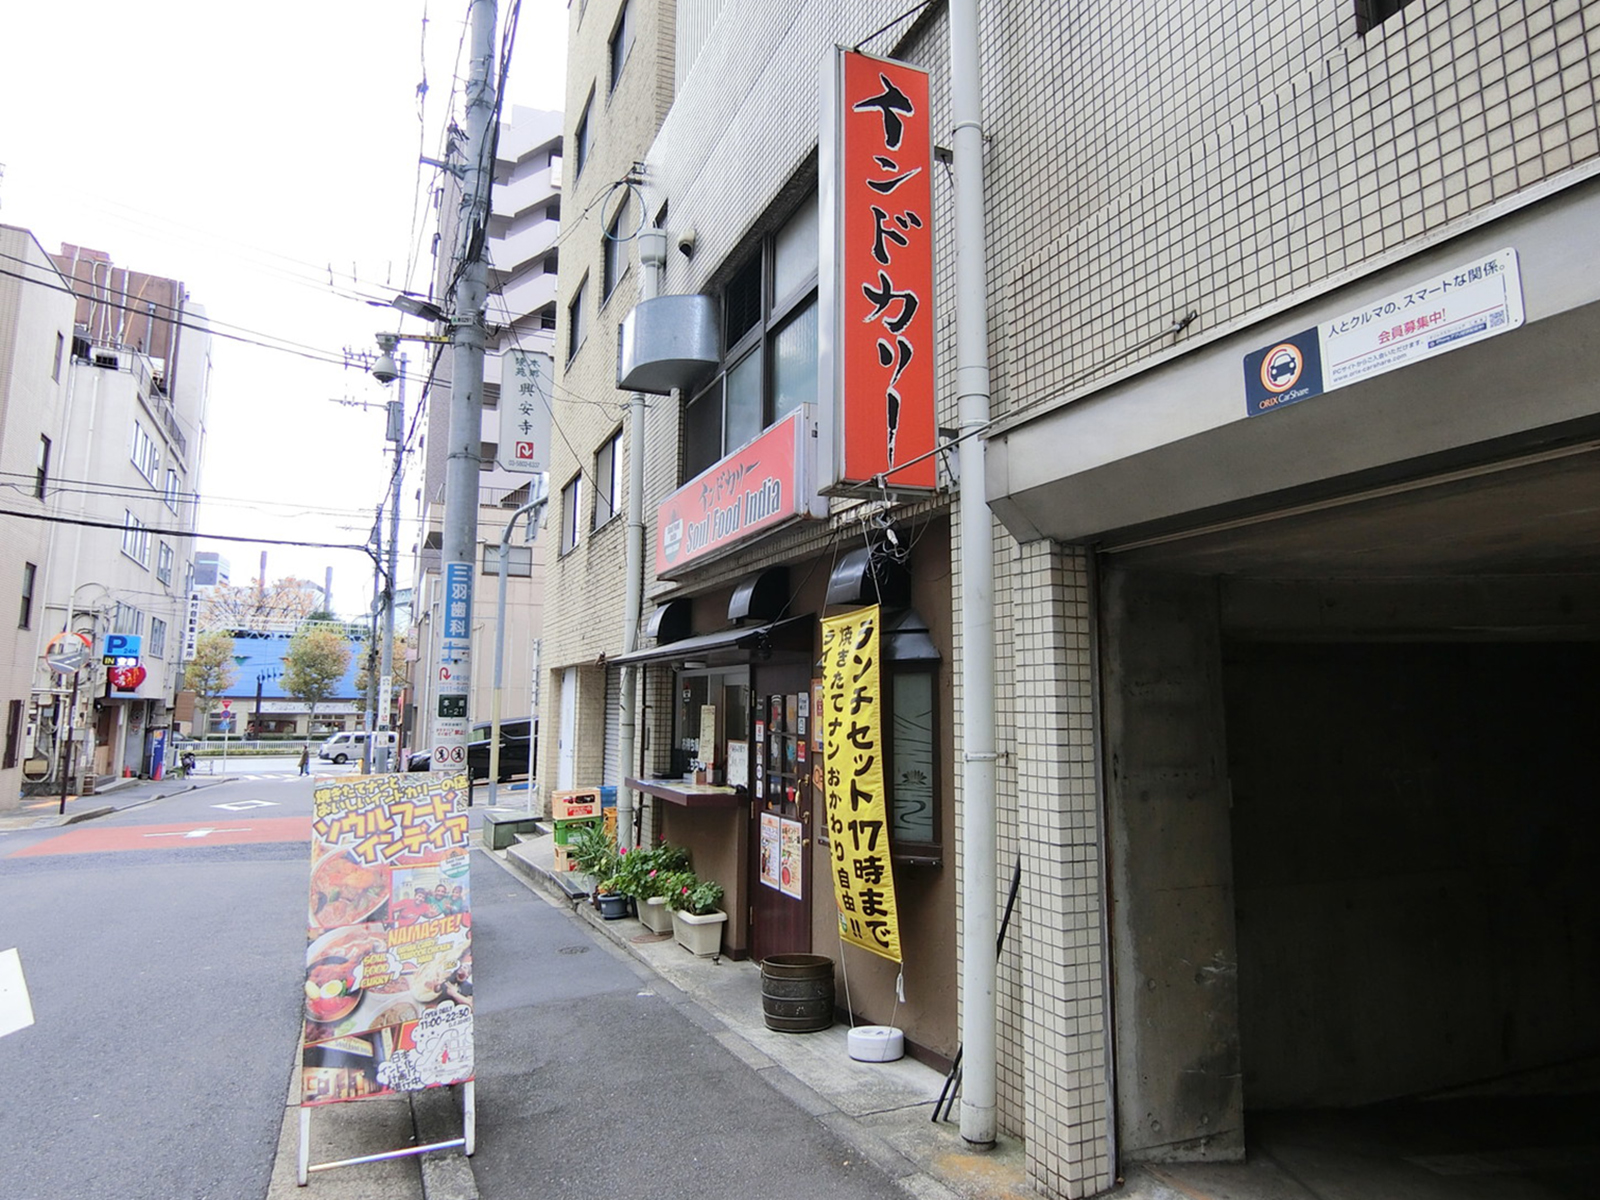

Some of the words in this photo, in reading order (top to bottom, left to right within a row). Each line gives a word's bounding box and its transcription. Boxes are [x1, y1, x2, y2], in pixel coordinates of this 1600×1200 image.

[1328, 258, 1505, 338] 人とクルマの、スマートな関係。
[1378, 308, 1446, 345] 会員募集中!
[518, 382, 535, 435] 興安寺
[1259, 396, 1279, 409] ORIX
[1279, 387, 1309, 403] CarShare
[687, 510, 710, 555] Soul
[711, 495, 742, 542] Food
[744, 477, 782, 528] India
[449, 565, 468, 636] 三羽歯科
[107, 635, 128, 653] P
[104, 657, 115, 665] IN
[443, 708, 464, 716] 1-21
[314, 775, 400, 804] 焼きたてナンと
[316, 776, 469, 818] おいしいインドカリーの店
[846, 618, 892, 949] ランチセット17時まで
[313, 791, 458, 844] ソウルフード
[353, 815, 469, 864] インディア
[387, 914, 462, 947] NAMASTE!
[363, 953, 387, 963] SOUL
[364, 963, 389, 976] FOOD
[361, 973, 394, 989] CURRY!
[424, 1010, 438, 1019] OPEN
